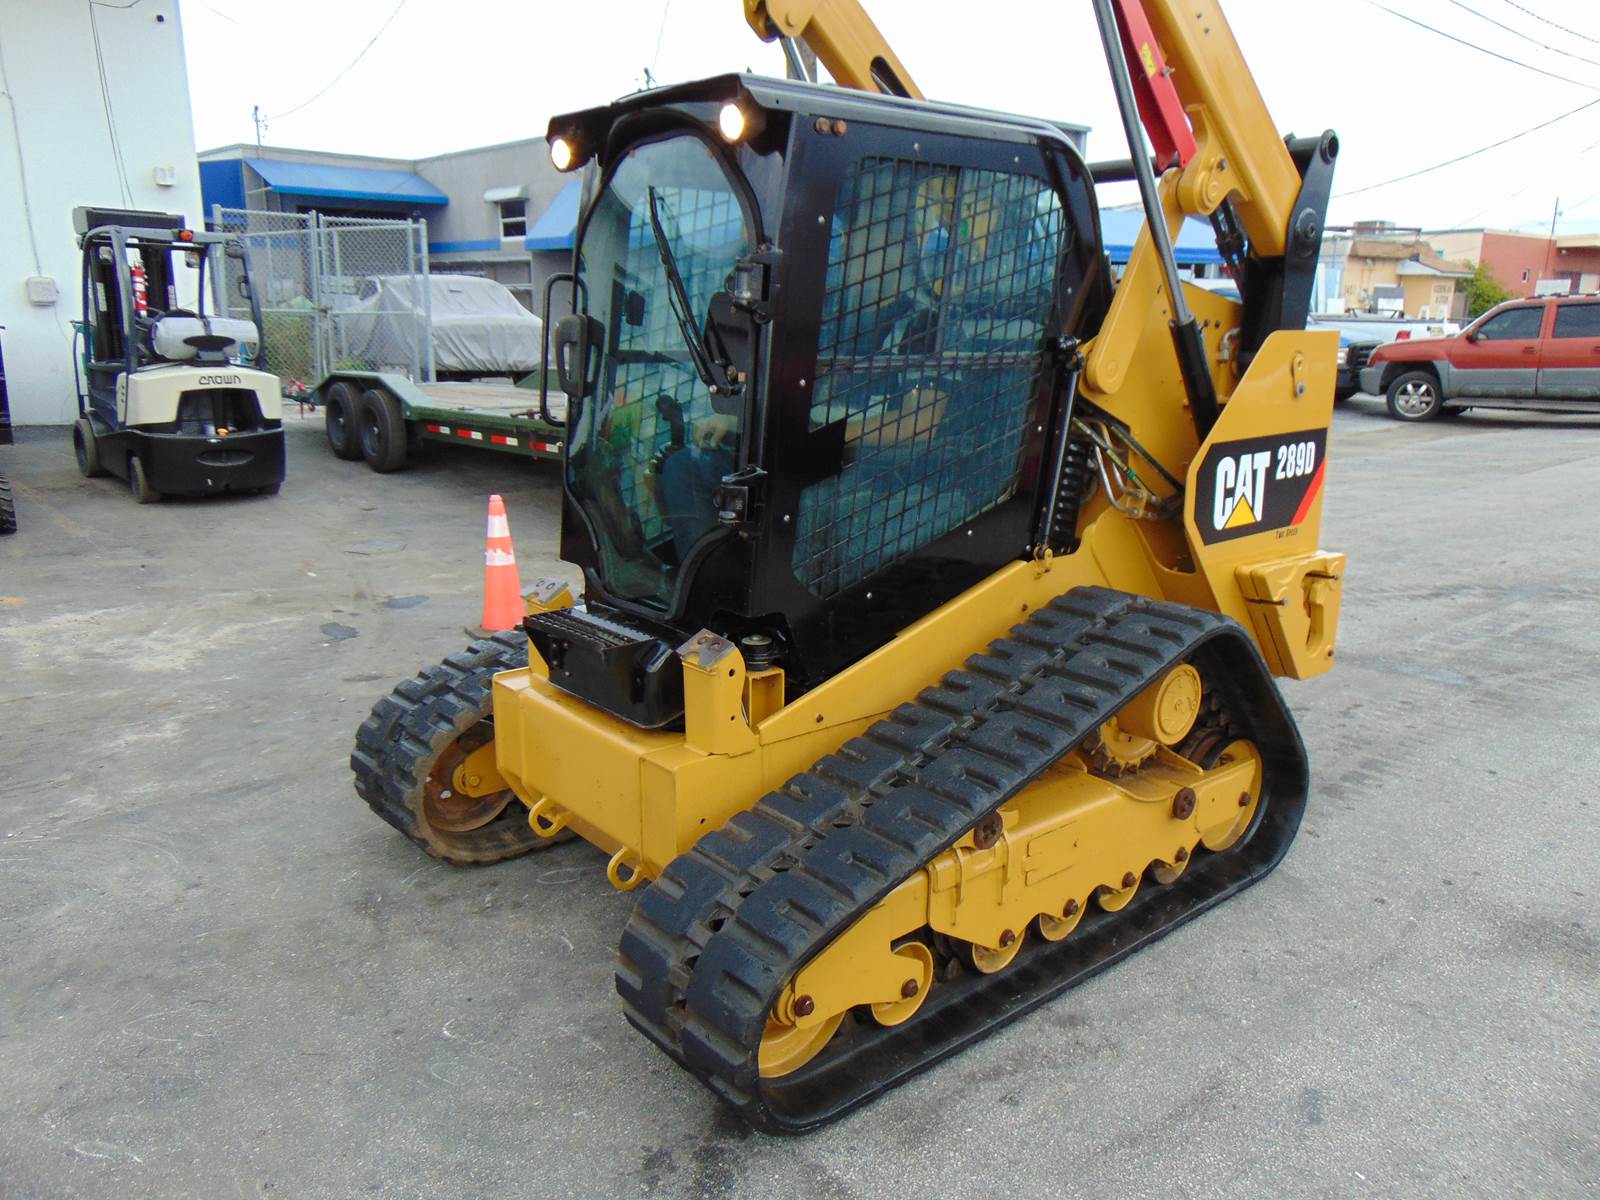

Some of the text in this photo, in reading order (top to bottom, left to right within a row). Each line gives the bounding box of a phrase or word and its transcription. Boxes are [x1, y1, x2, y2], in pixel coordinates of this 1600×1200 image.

[198, 375, 241, 385] CROWN
[1213, 441, 1316, 530] CAT 289D
